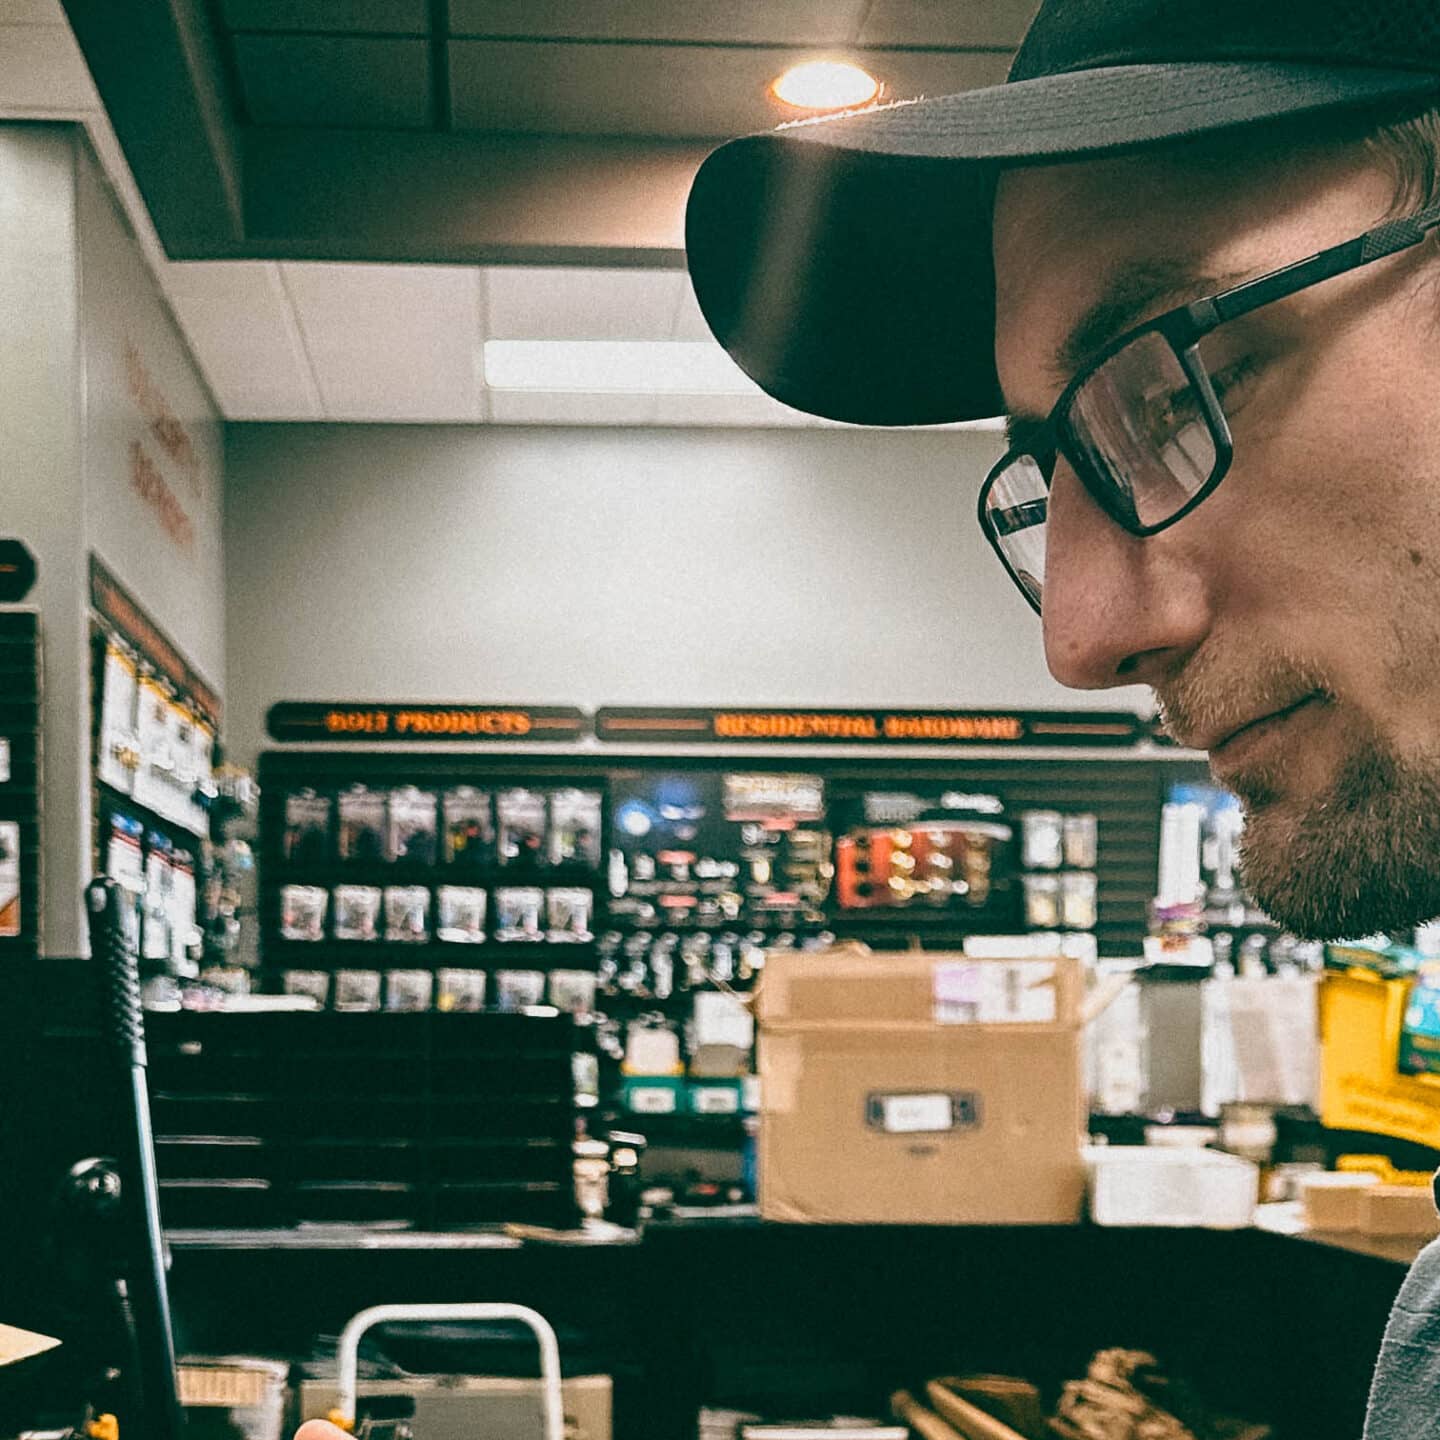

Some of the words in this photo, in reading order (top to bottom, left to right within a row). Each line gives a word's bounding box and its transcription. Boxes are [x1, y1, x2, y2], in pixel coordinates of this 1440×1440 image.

[395, 711, 532, 735] PRODUCTS
[714, 713, 877, 738] RESIDENTIAL
[884, 715, 1023, 740] HARDWARE
